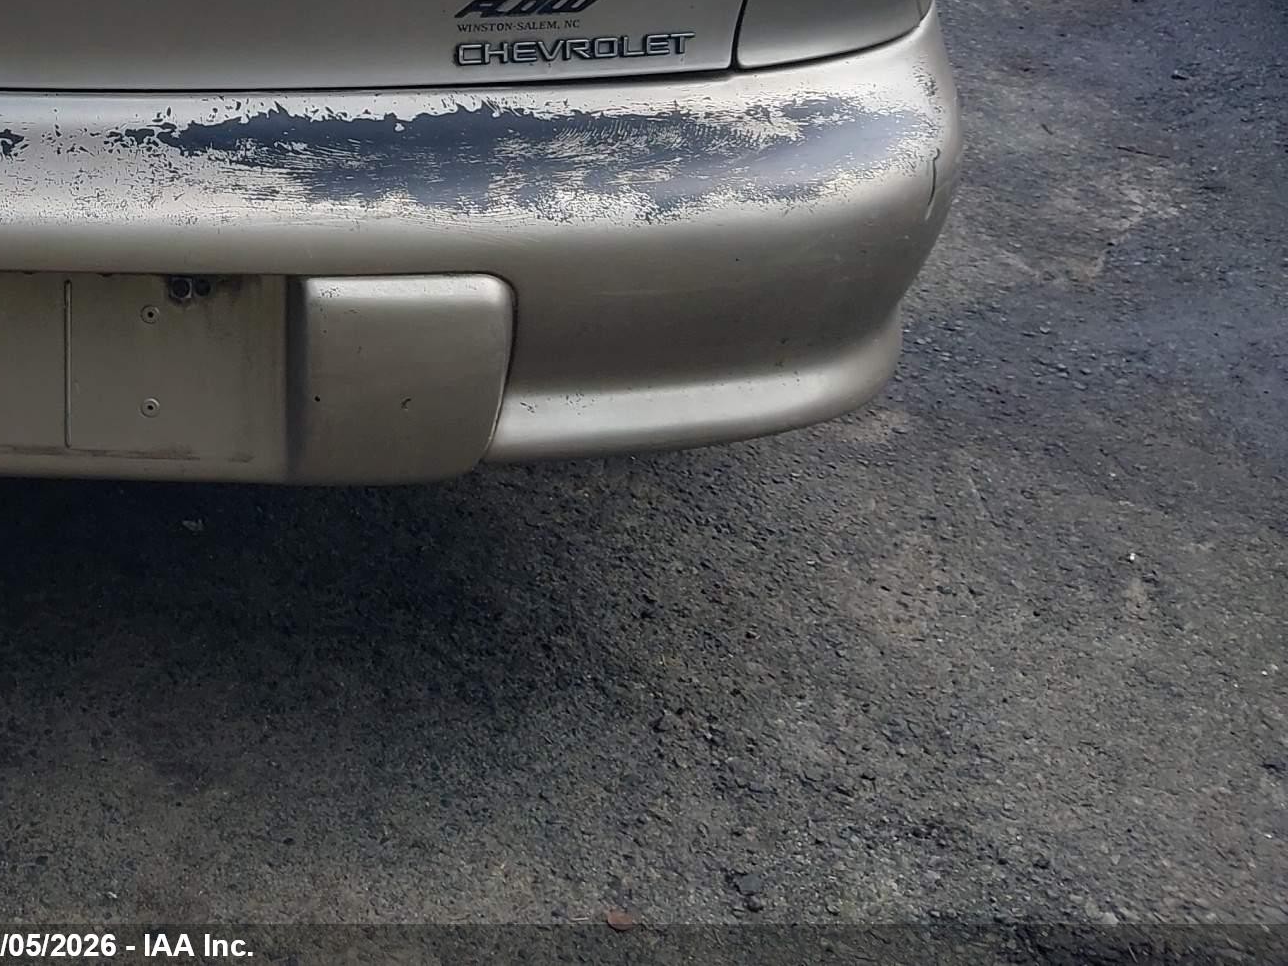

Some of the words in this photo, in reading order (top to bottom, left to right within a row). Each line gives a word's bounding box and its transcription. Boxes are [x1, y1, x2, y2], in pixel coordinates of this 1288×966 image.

[457, 20, 560, 33] WINSTON-SALEM,
[563, 19, 580, 28] NC
[455, 31, 697, 66] CHEVROLET
